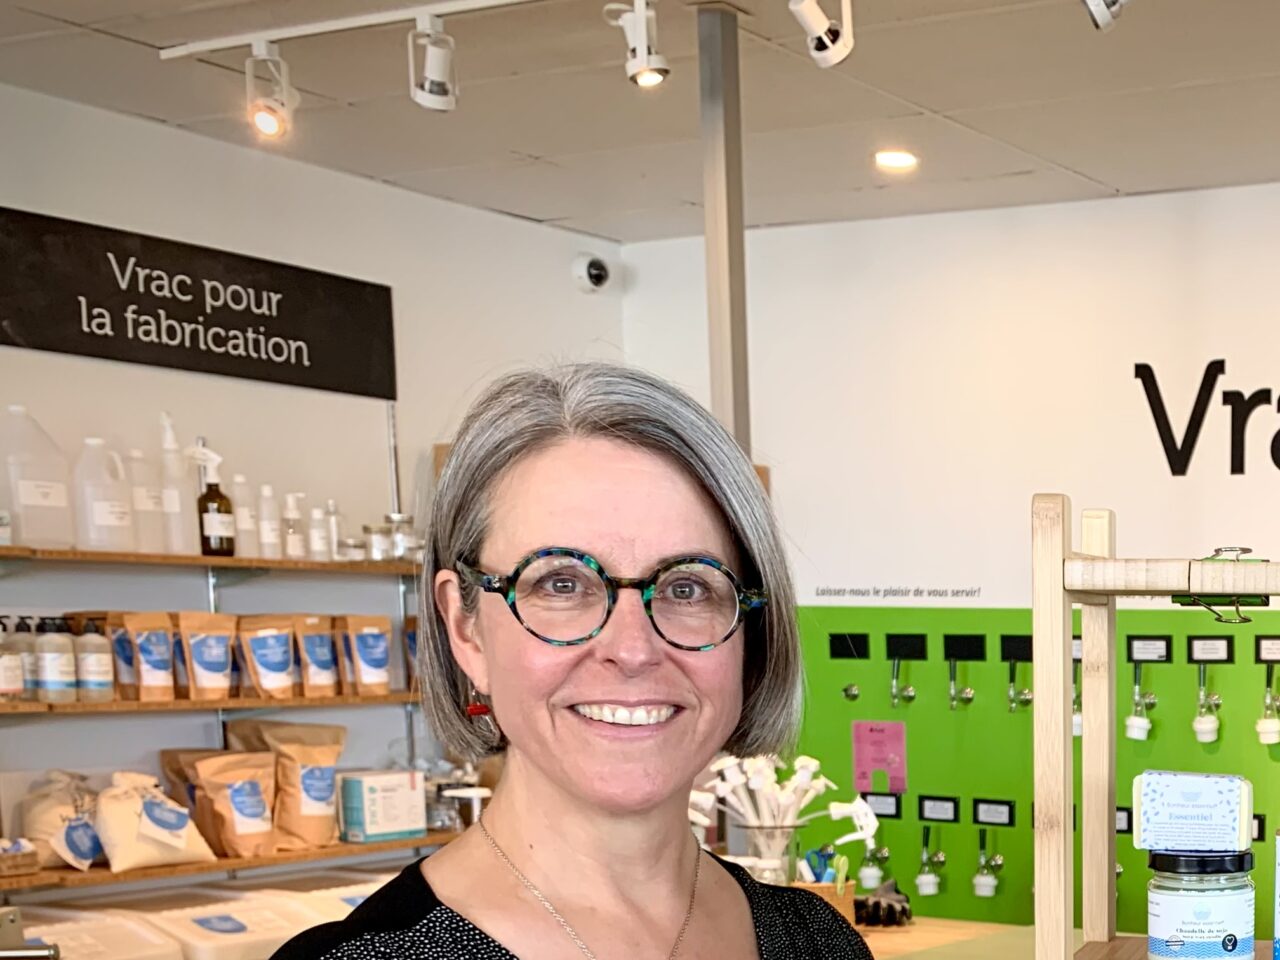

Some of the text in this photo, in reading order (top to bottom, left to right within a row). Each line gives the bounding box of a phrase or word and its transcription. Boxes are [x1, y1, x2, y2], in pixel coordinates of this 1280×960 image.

[107, 252, 283, 317] Vrac pour
[77, 296, 311, 367] la fabrication
